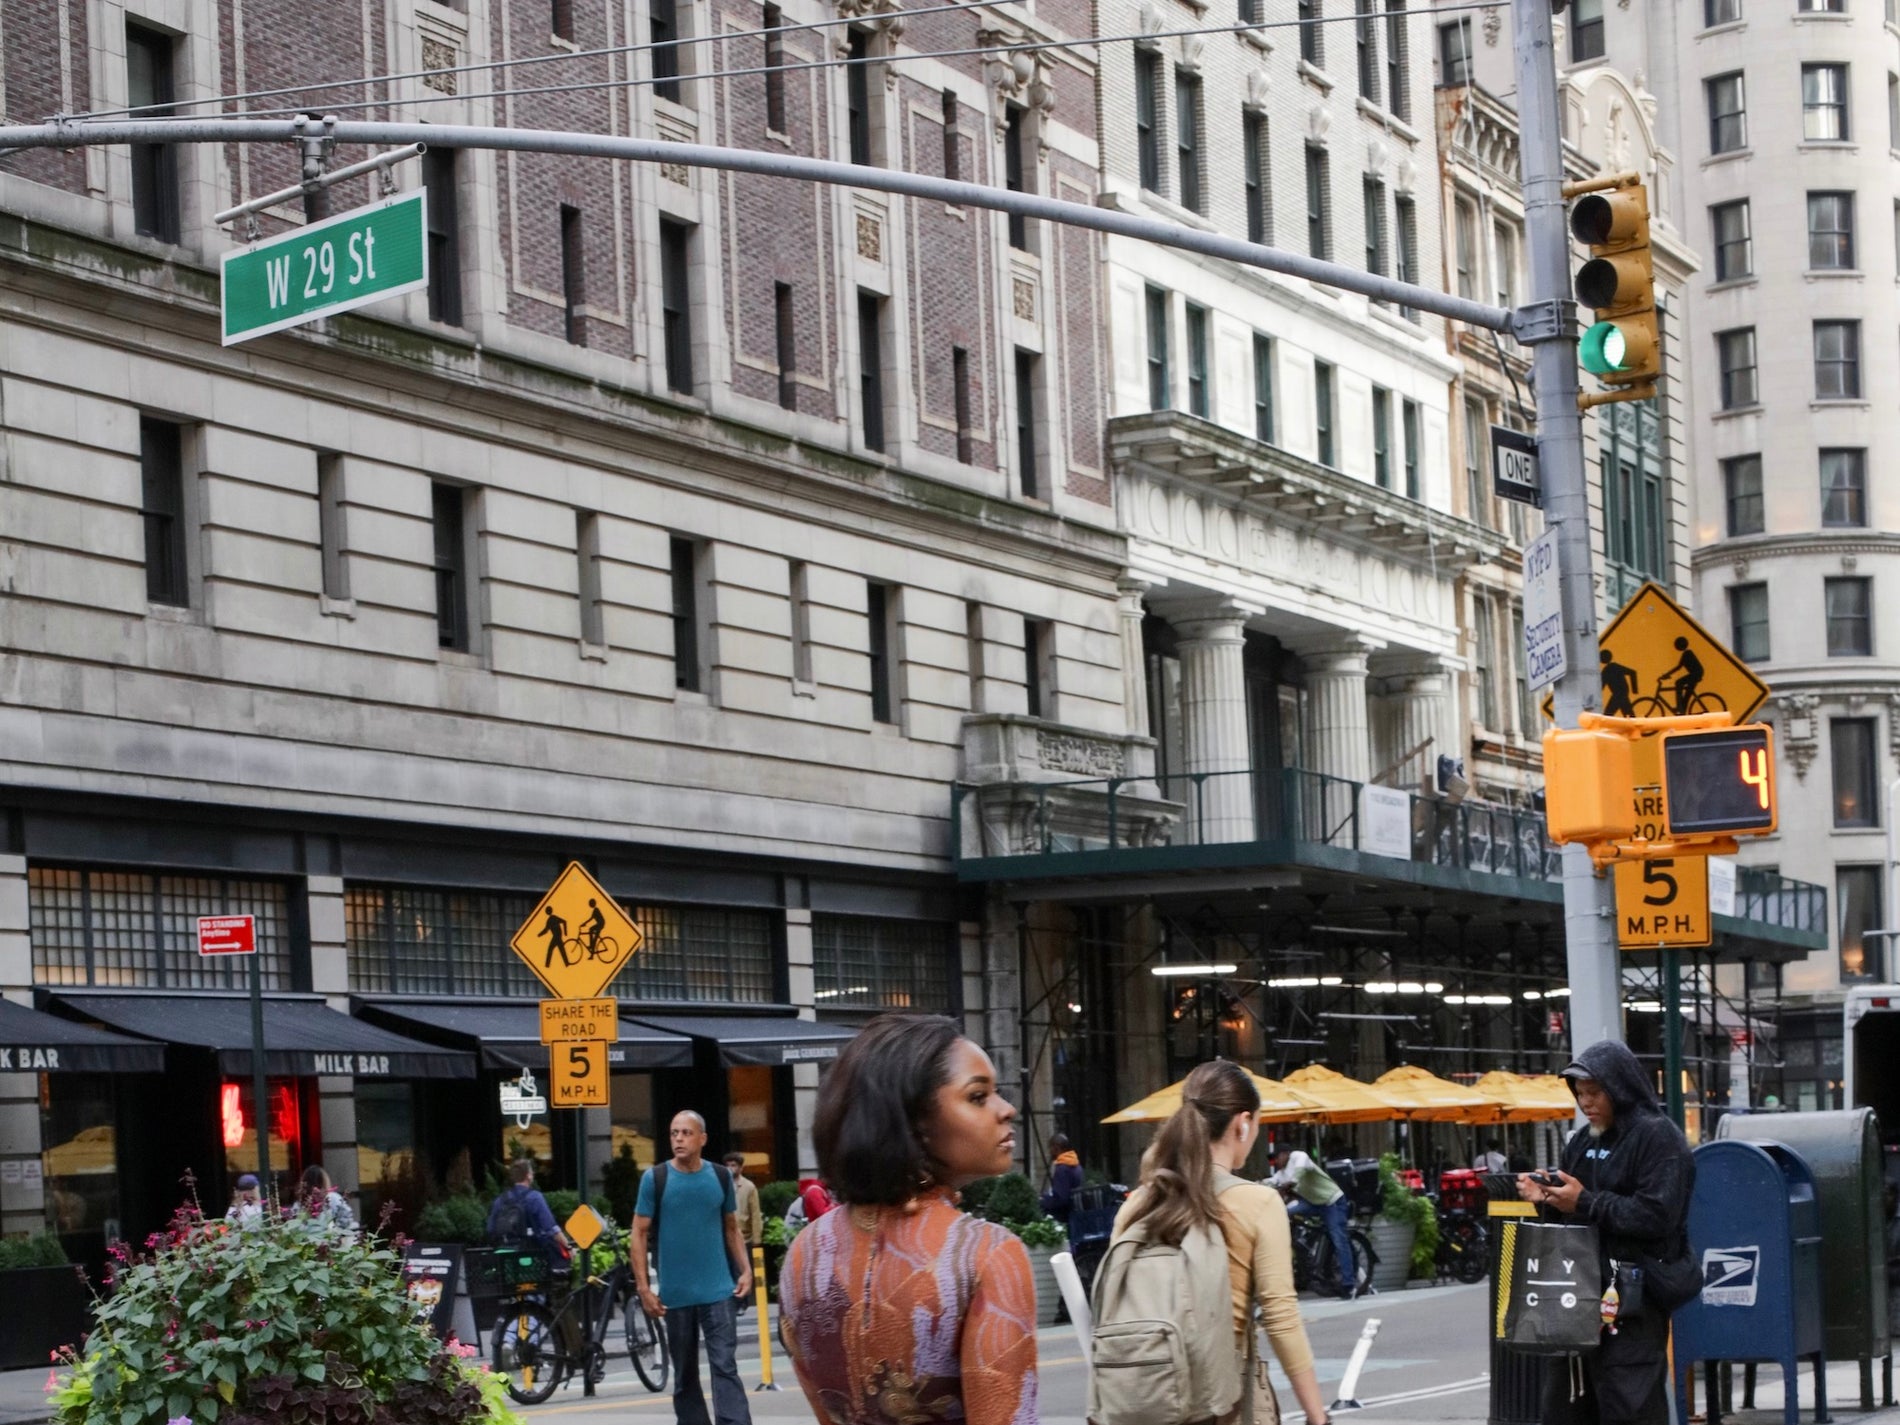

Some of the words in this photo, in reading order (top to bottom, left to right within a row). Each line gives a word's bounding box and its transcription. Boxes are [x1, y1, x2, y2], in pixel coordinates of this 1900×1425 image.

[266, 254, 290, 309] W
[303, 241, 335, 299] 29
[348, 226, 376, 285] St
[1505, 452, 1531, 484] ONE
[1527, 543, 1553, 583] NYPD
[1525, 611, 1561, 652] SECURITY
[1528, 643, 1563, 681] CAMERA
[1740, 748, 1769, 809] 4
[1642, 858, 1678, 907] 5
[1627, 914, 1695, 935] M.P.H.
[545, 1006, 585, 1019] SHARE
[590, 1004, 612, 1018] THE
[562, 1023, 596, 1036] ROAD
[19, 1048, 60, 1068] BAR
[314, 1054, 354, 1073] MILK
[358, 1055, 390, 1074] BAR
[569, 1046, 590, 1079] 5
[1526, 1292, 1539, 1307] C
